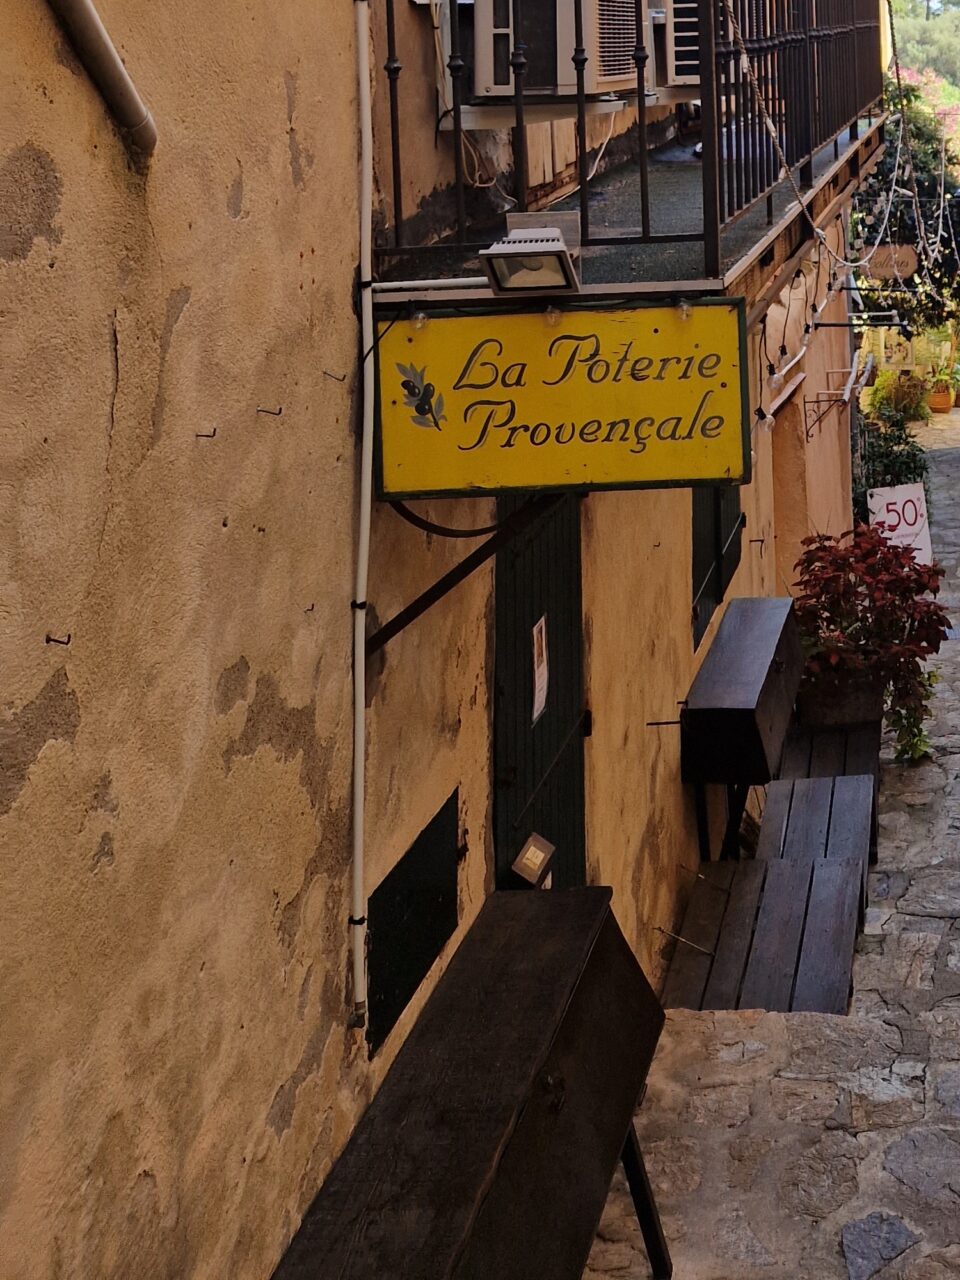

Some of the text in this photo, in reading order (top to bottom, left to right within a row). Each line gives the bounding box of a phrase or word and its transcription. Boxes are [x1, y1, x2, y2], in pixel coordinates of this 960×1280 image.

[453, 334, 722, 391] La Poterie
[457, 389, 725, 453] Provençale
